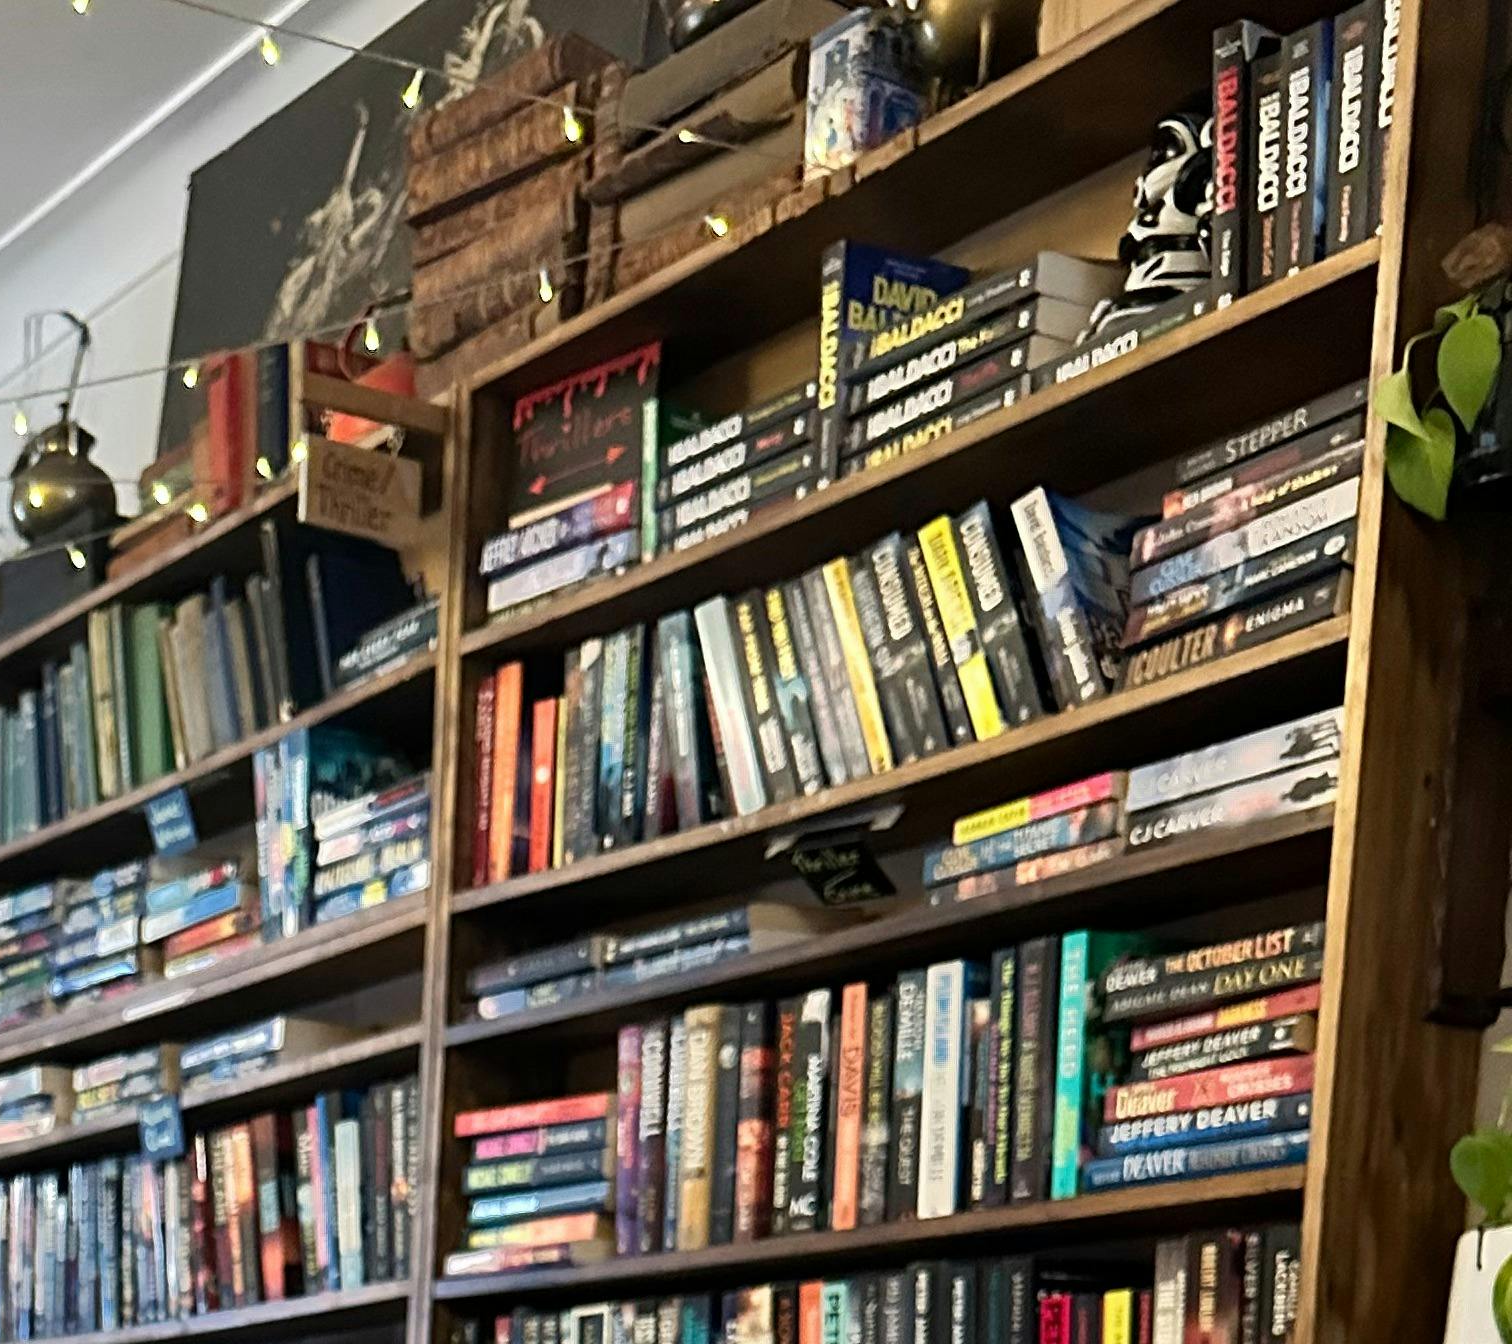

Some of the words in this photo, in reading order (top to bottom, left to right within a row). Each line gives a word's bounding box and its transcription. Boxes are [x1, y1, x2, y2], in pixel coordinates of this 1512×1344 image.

[1286, 74, 1310, 199] BALDACCI
[1339, 48, 1363, 174] BALDACCI
[1216, 74, 1237, 215] BALDACCI
[1258, 97, 1280, 213] BALDACCI
[819, 286, 841, 409] BALDACCI
[876, 297, 965, 354] BALDACCI
[876, 341, 957, 398] BALDACCI
[876, 378, 953, 437] BALDACCI
[1224, 407, 1308, 463] STEPPER
[959, 511, 1004, 613] CONSUMED
[1245, 598, 1304, 632] ENIGMA
[1154, 807, 1225, 840] CARVER
[1185, 943, 1255, 974] OCTOBER
[1254, 927, 1297, 960] LIST
[1212, 967, 1257, 997] DAY
[1258, 955, 1307, 986] ONE
[1105, 967, 1159, 994] DEAVER
[1201, 1025, 1263, 1053] DEAVER
[840, 1045, 861, 1119] DAVIS
[1109, 1112, 1195, 1145] JEFFERY
[1194, 1098, 1279, 1131] DEAVER
[1123, 1148, 1187, 1182] DEAVER
